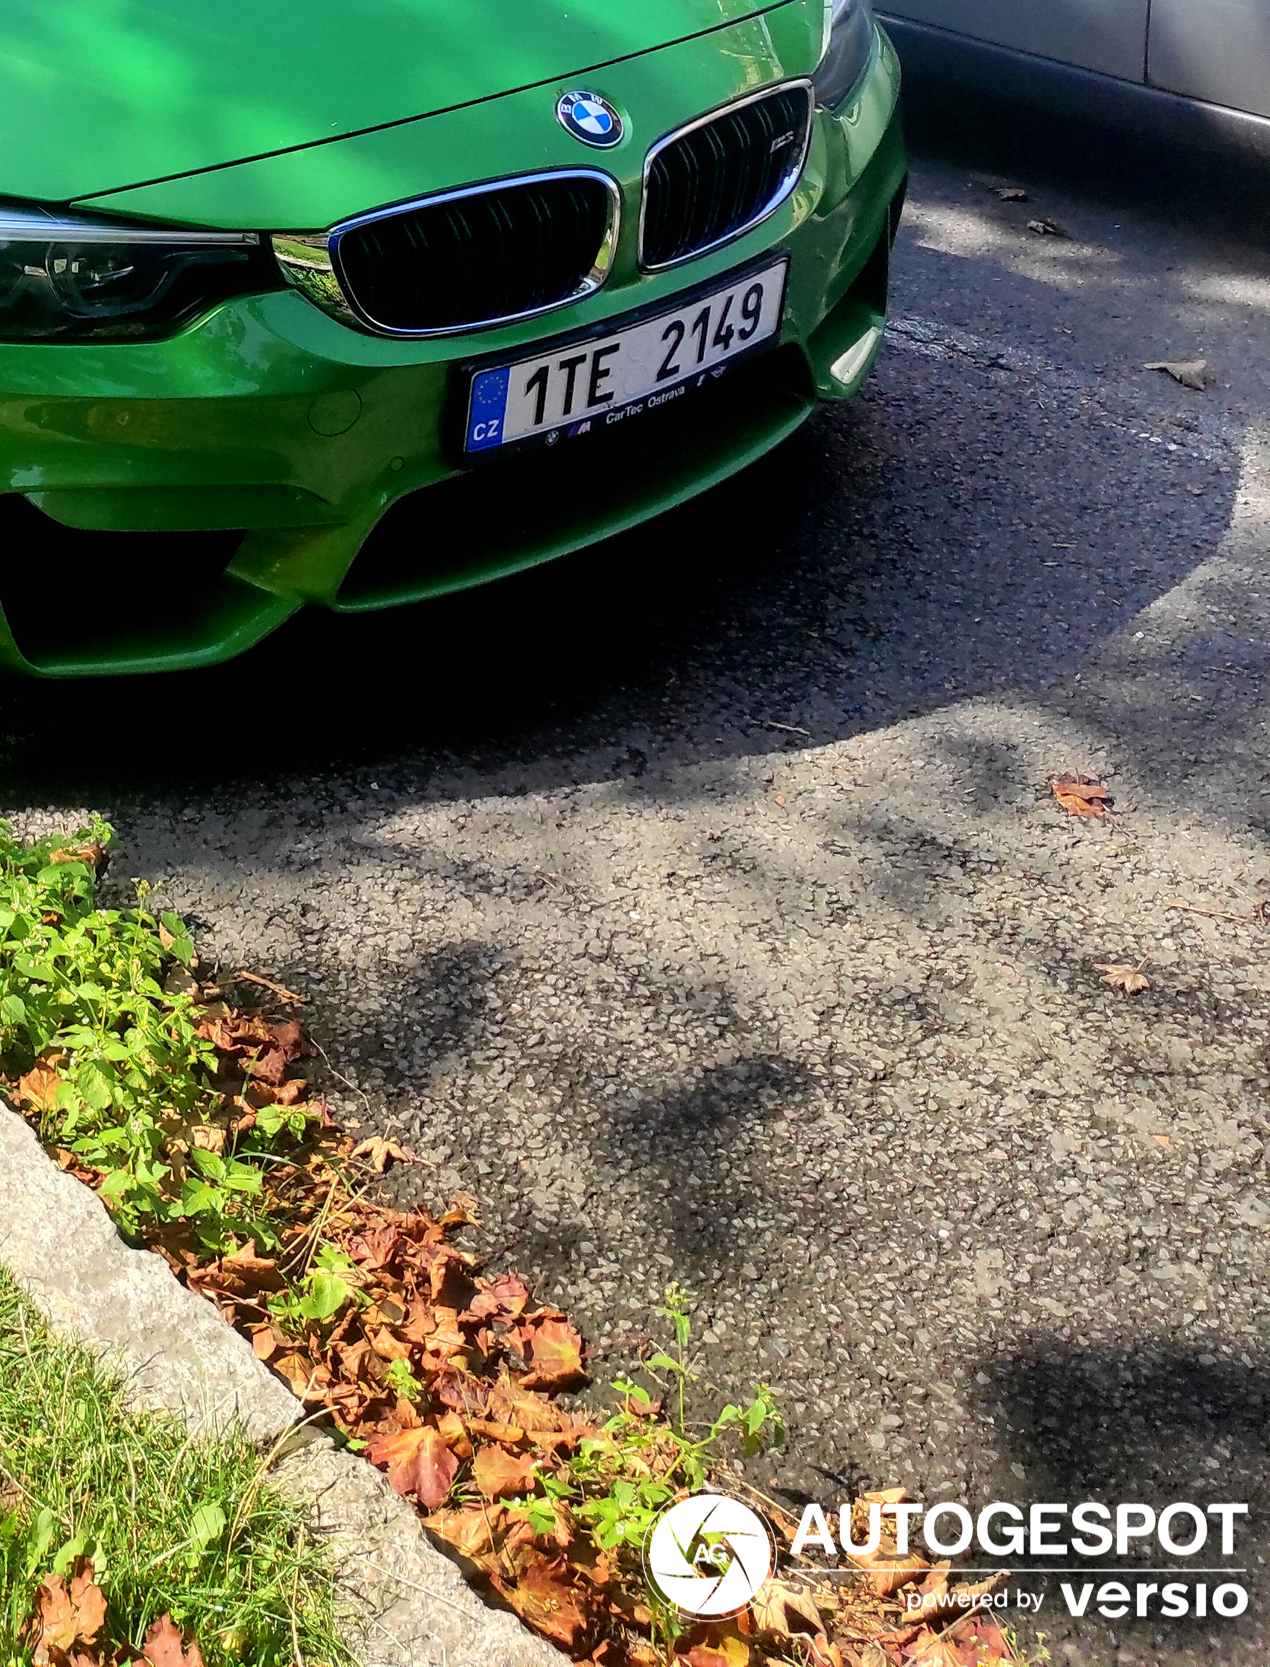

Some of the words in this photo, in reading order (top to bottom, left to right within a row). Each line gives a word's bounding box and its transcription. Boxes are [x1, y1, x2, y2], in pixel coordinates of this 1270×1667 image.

[560, 92, 603, 114] BMW
[523, 343, 620, 426] 1TE
[656, 283, 764, 383] 2149
[647, 385, 686, 409] Ostrava
[474, 419, 500, 442] CZ
